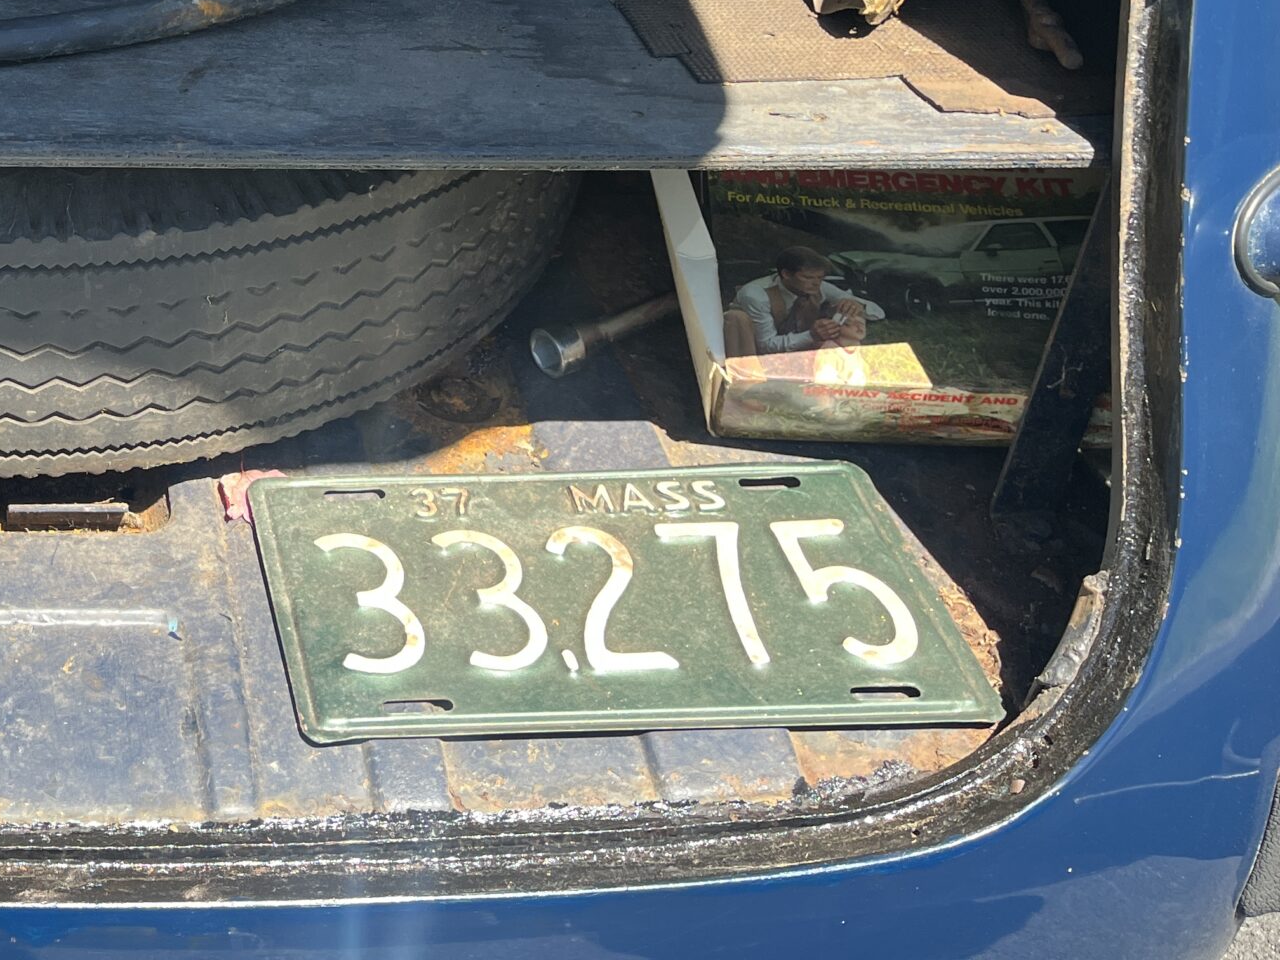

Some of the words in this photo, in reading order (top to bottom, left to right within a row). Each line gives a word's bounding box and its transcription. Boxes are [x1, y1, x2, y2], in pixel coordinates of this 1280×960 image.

[797, 171, 1008, 196] EMERGENCY
[1015, 177, 1074, 198] KIT
[727, 192, 751, 203] For
[800, 195, 840, 208] Truck
[845, 199, 856, 209] &
[861, 198, 955, 214] Recreational
[959, 203, 1024, 217] Vehicles
[980, 272, 1014, 283] There
[1017, 276, 1047, 285] were
[981, 286, 1008, 294] over
[1016, 298, 1042, 308] This
[887, 390, 974, 404] ACCIDENT
[982, 396, 1019, 406] AND
[410, 487, 472, 518] 37
[569, 480, 726, 515] MASS
